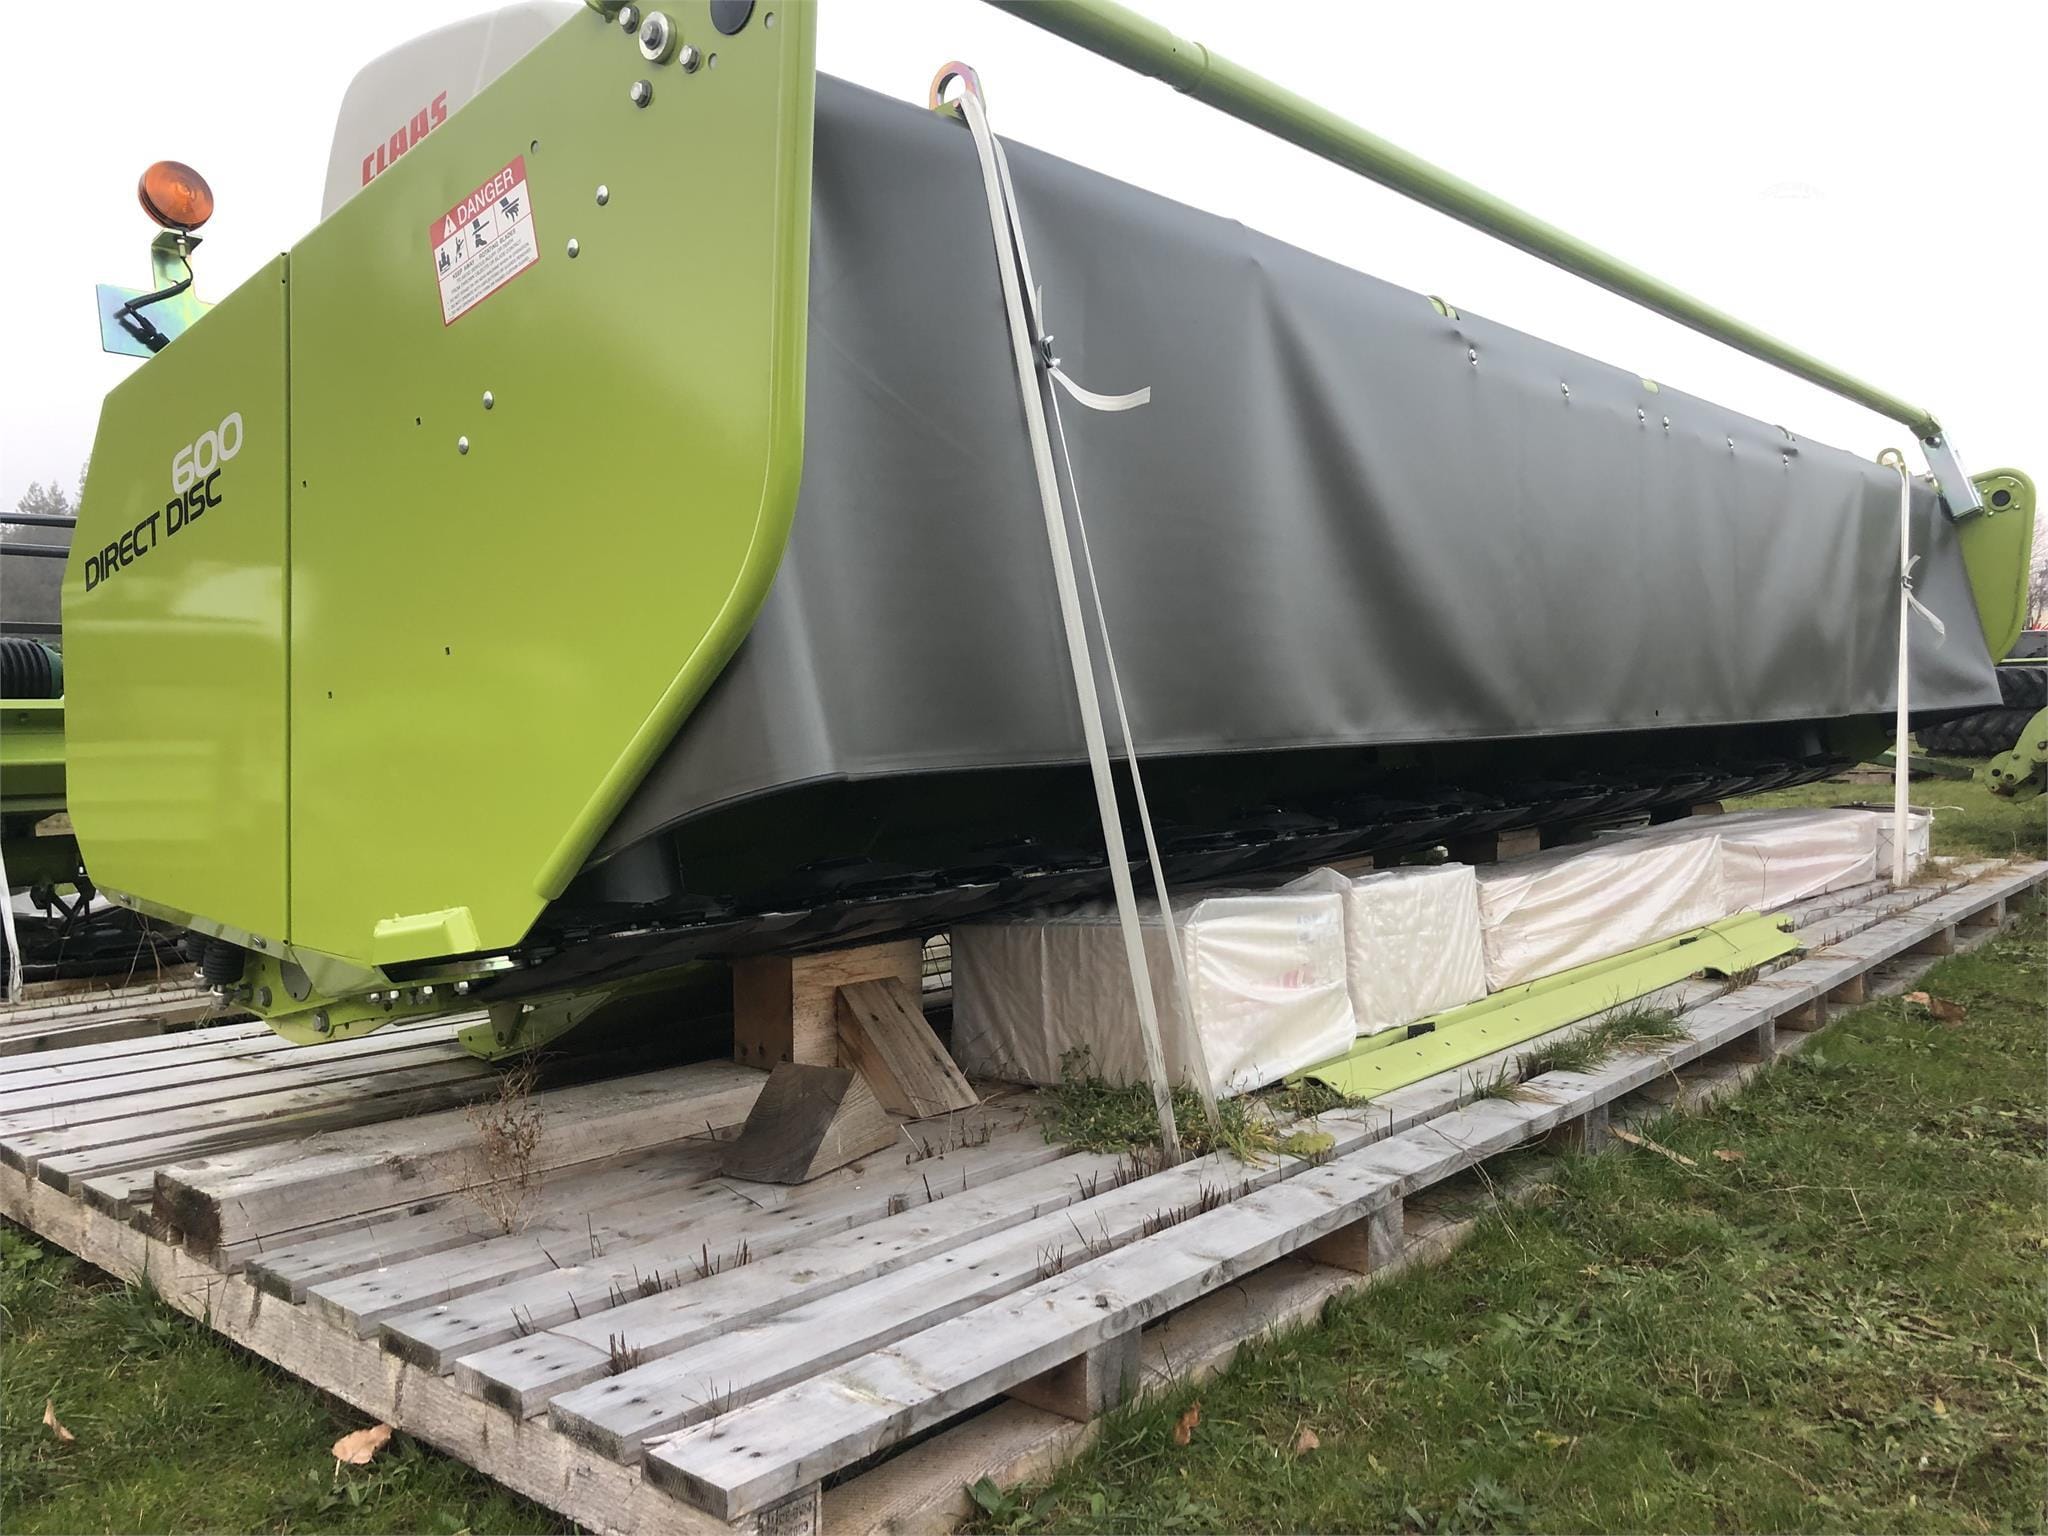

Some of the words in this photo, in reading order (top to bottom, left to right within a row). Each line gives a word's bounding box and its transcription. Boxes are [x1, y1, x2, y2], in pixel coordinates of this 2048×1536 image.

[362, 90, 447, 187] CLAAS
[457, 168, 514, 225] DANGER
[172, 412, 243, 494] 600
[85, 511, 160, 592] DIRECT
[166, 468, 222, 537] DISC
